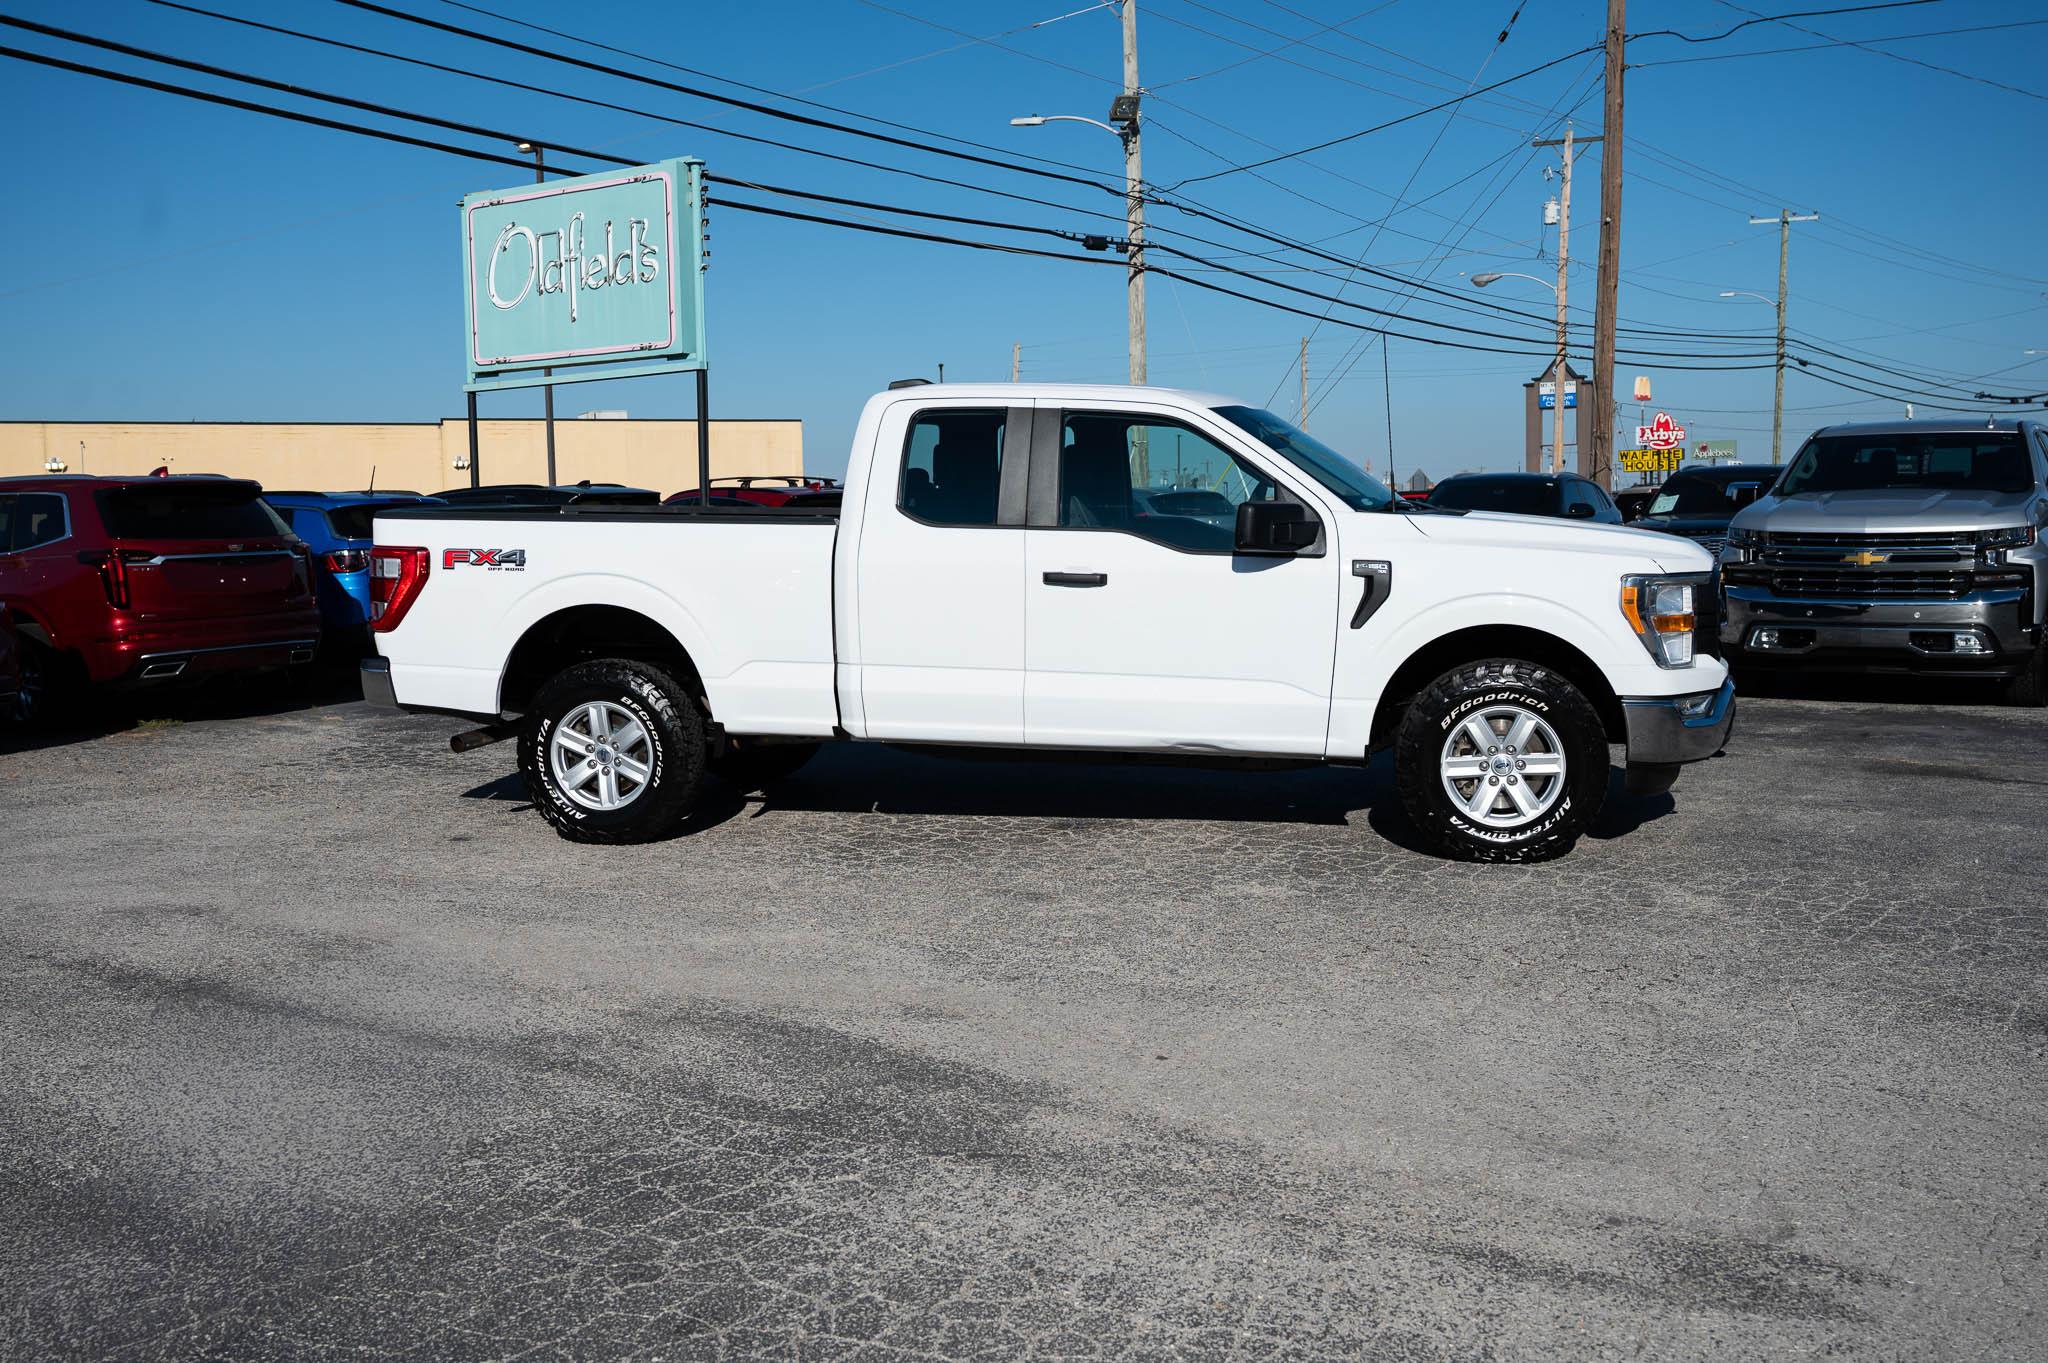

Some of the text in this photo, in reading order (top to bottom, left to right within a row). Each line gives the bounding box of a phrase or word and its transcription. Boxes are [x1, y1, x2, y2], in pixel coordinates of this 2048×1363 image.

[487, 211, 659, 323] Oldfield's
[1642, 427, 1685, 443] Arby's
[1619, 449, 1681, 461] WAFFLE
[1625, 461, 1675, 471] HOUSE
[443, 549, 526, 570] FX4
[1440, 691, 1550, 730] BFGoodrich
[537, 718, 552, 744] T/A
[620, 696, 664, 788] BFGoodrich
